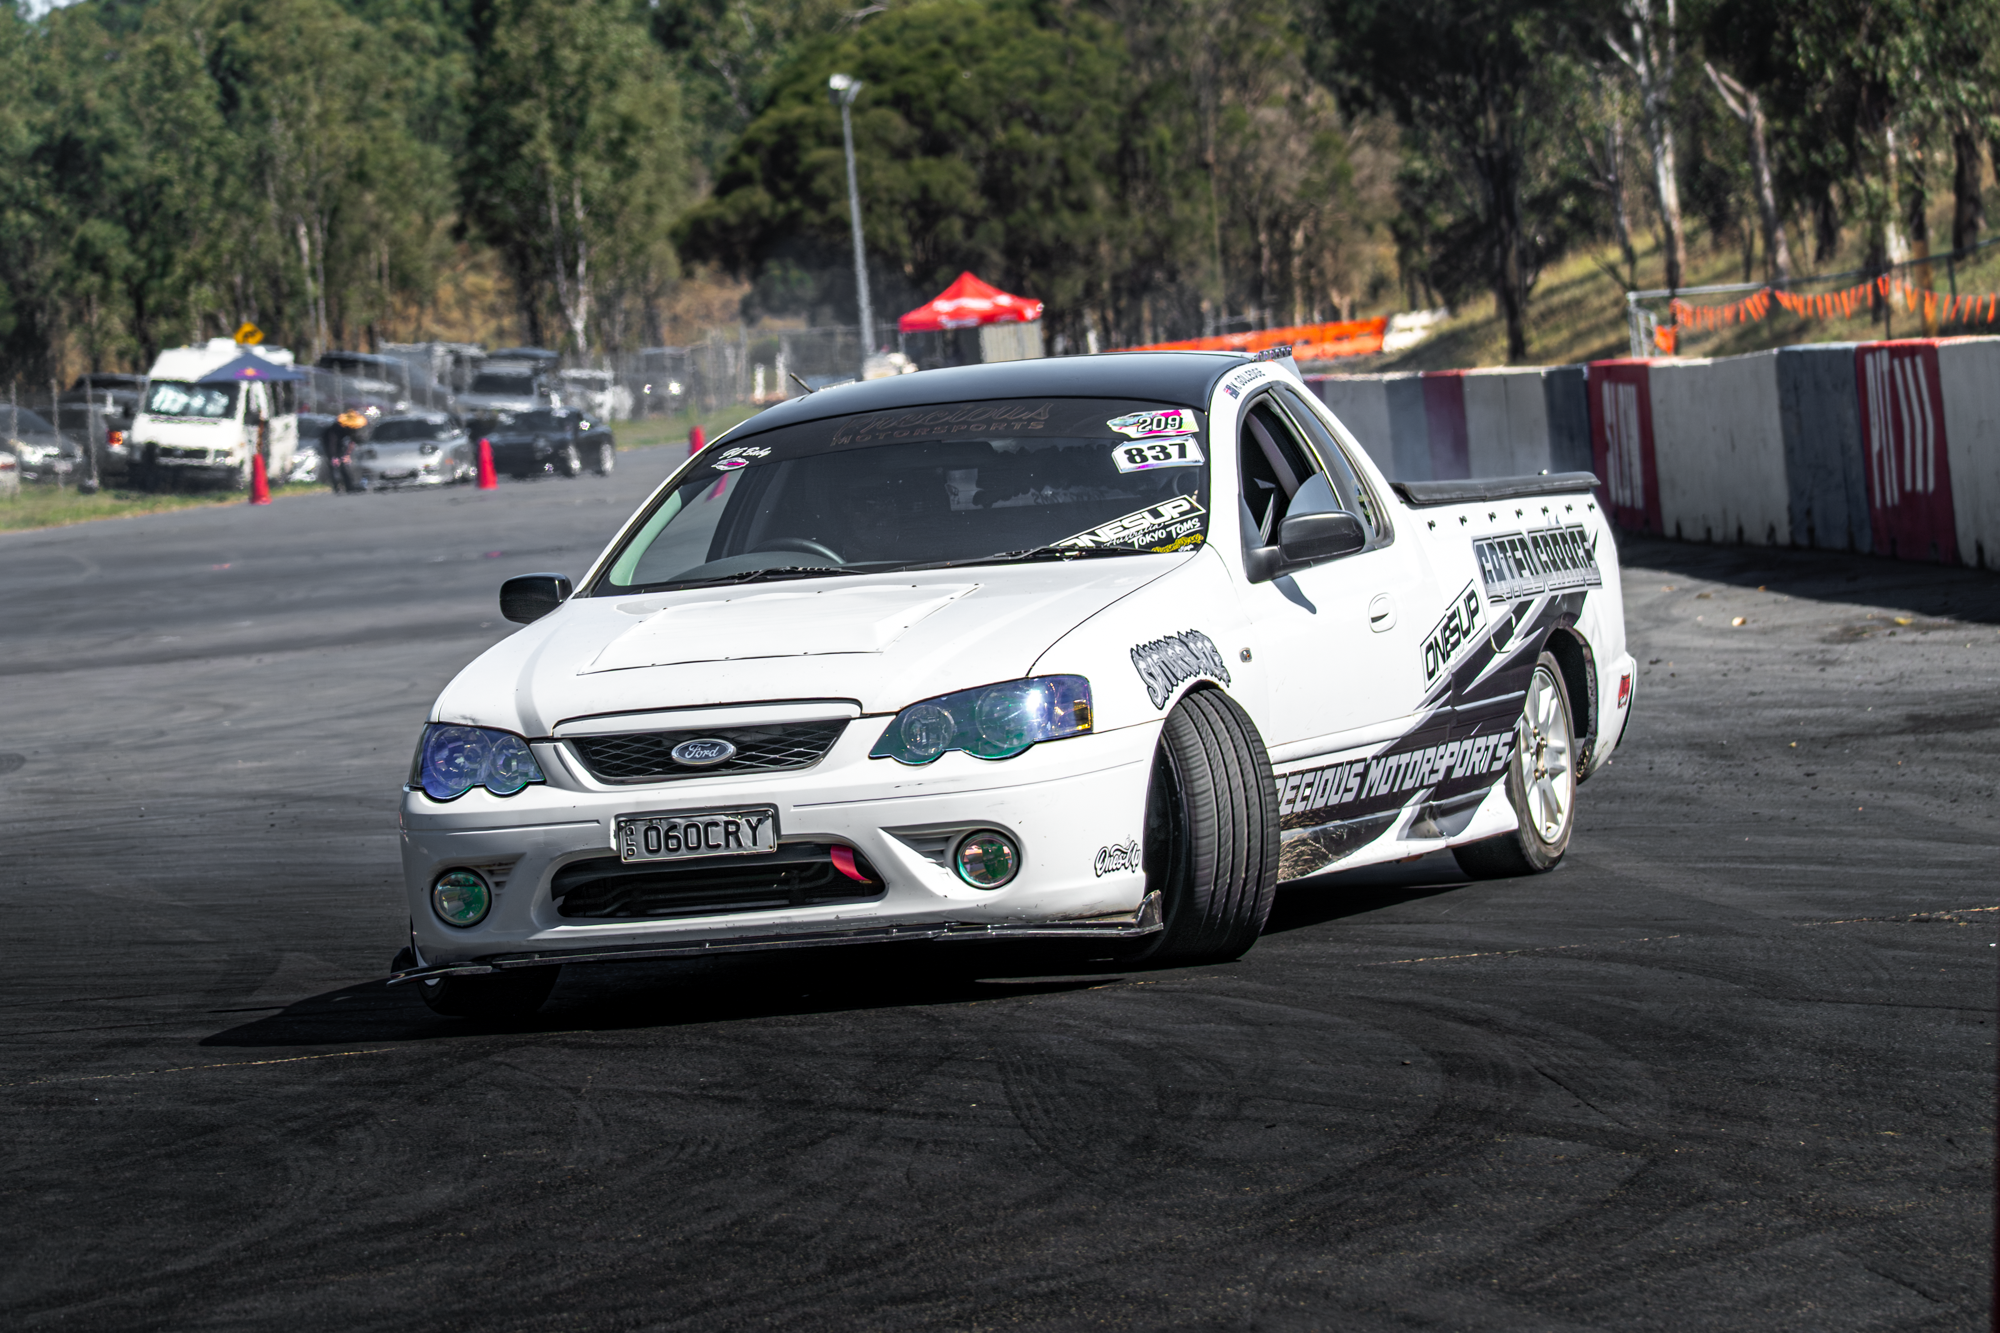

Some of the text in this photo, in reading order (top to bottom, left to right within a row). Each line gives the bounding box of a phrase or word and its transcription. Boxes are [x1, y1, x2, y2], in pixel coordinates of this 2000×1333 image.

[830, 420, 1046, 447] MOTORSPORTS
[1137, 415, 1183, 433] 209
[1123, 442, 1187, 465] 837
[1127, 528, 1167, 549] TOKYO
[1165, 517, 1201, 538] TOMS
[1424, 588, 1480, 682] ONESUP
[685, 743, 720, 759] Ford
[1361, 731, 1514, 800] MOTORSPORTS
